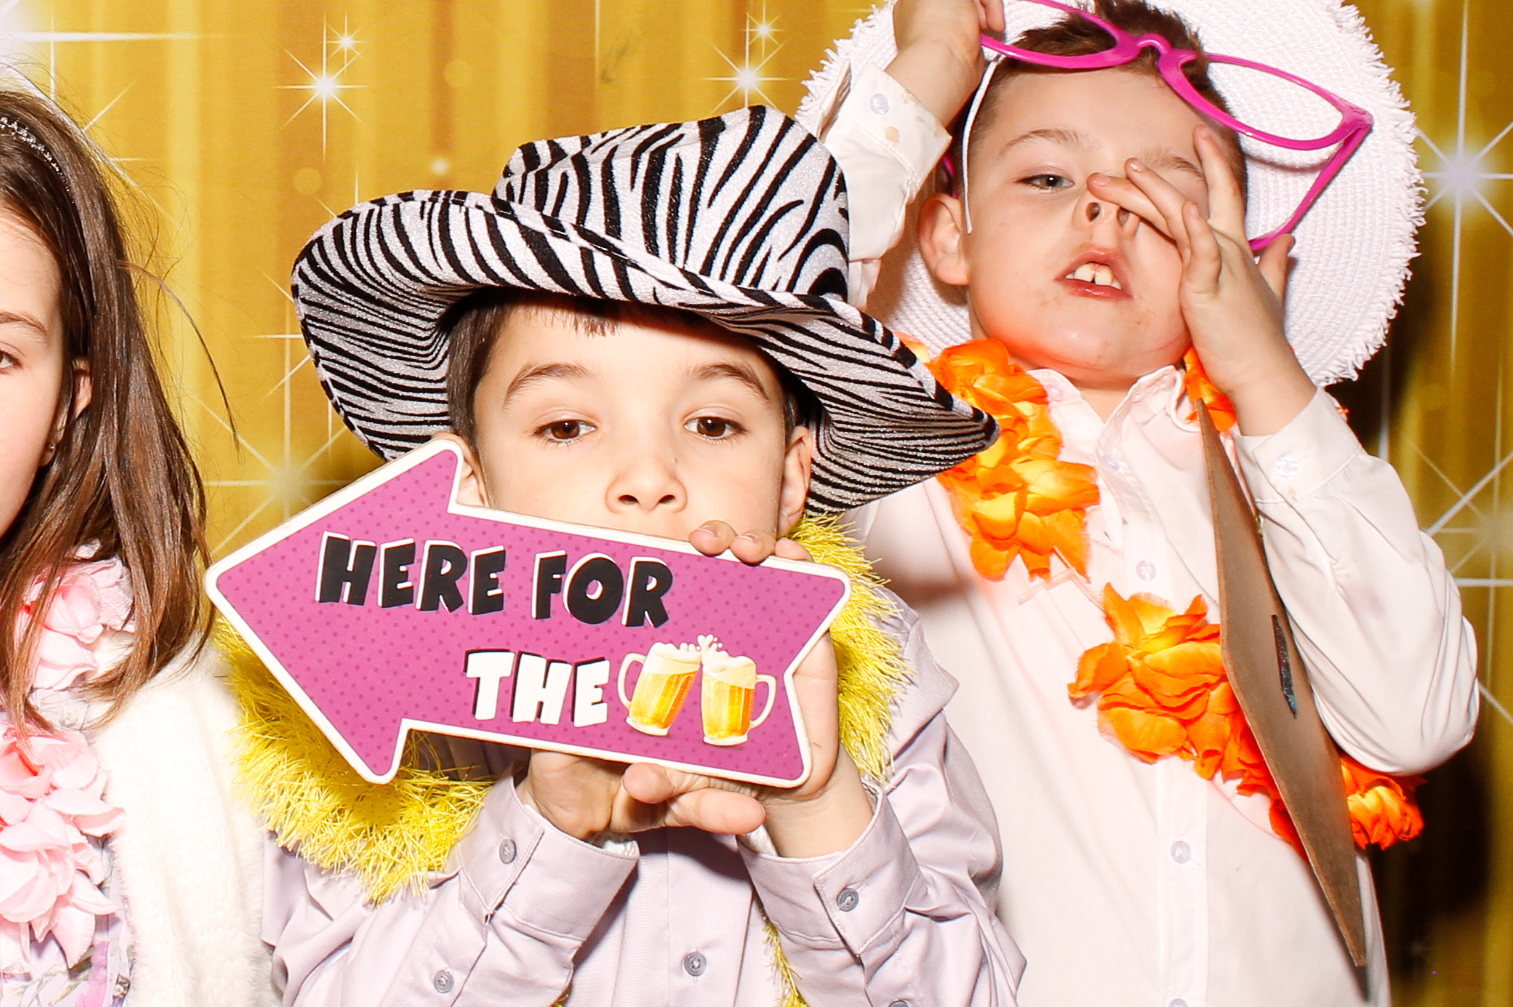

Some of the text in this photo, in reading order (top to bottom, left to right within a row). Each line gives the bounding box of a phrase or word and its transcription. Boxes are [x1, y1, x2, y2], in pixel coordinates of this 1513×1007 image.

[314, 531, 674, 629] HERE FOR
[464, 648, 612, 727] THE
